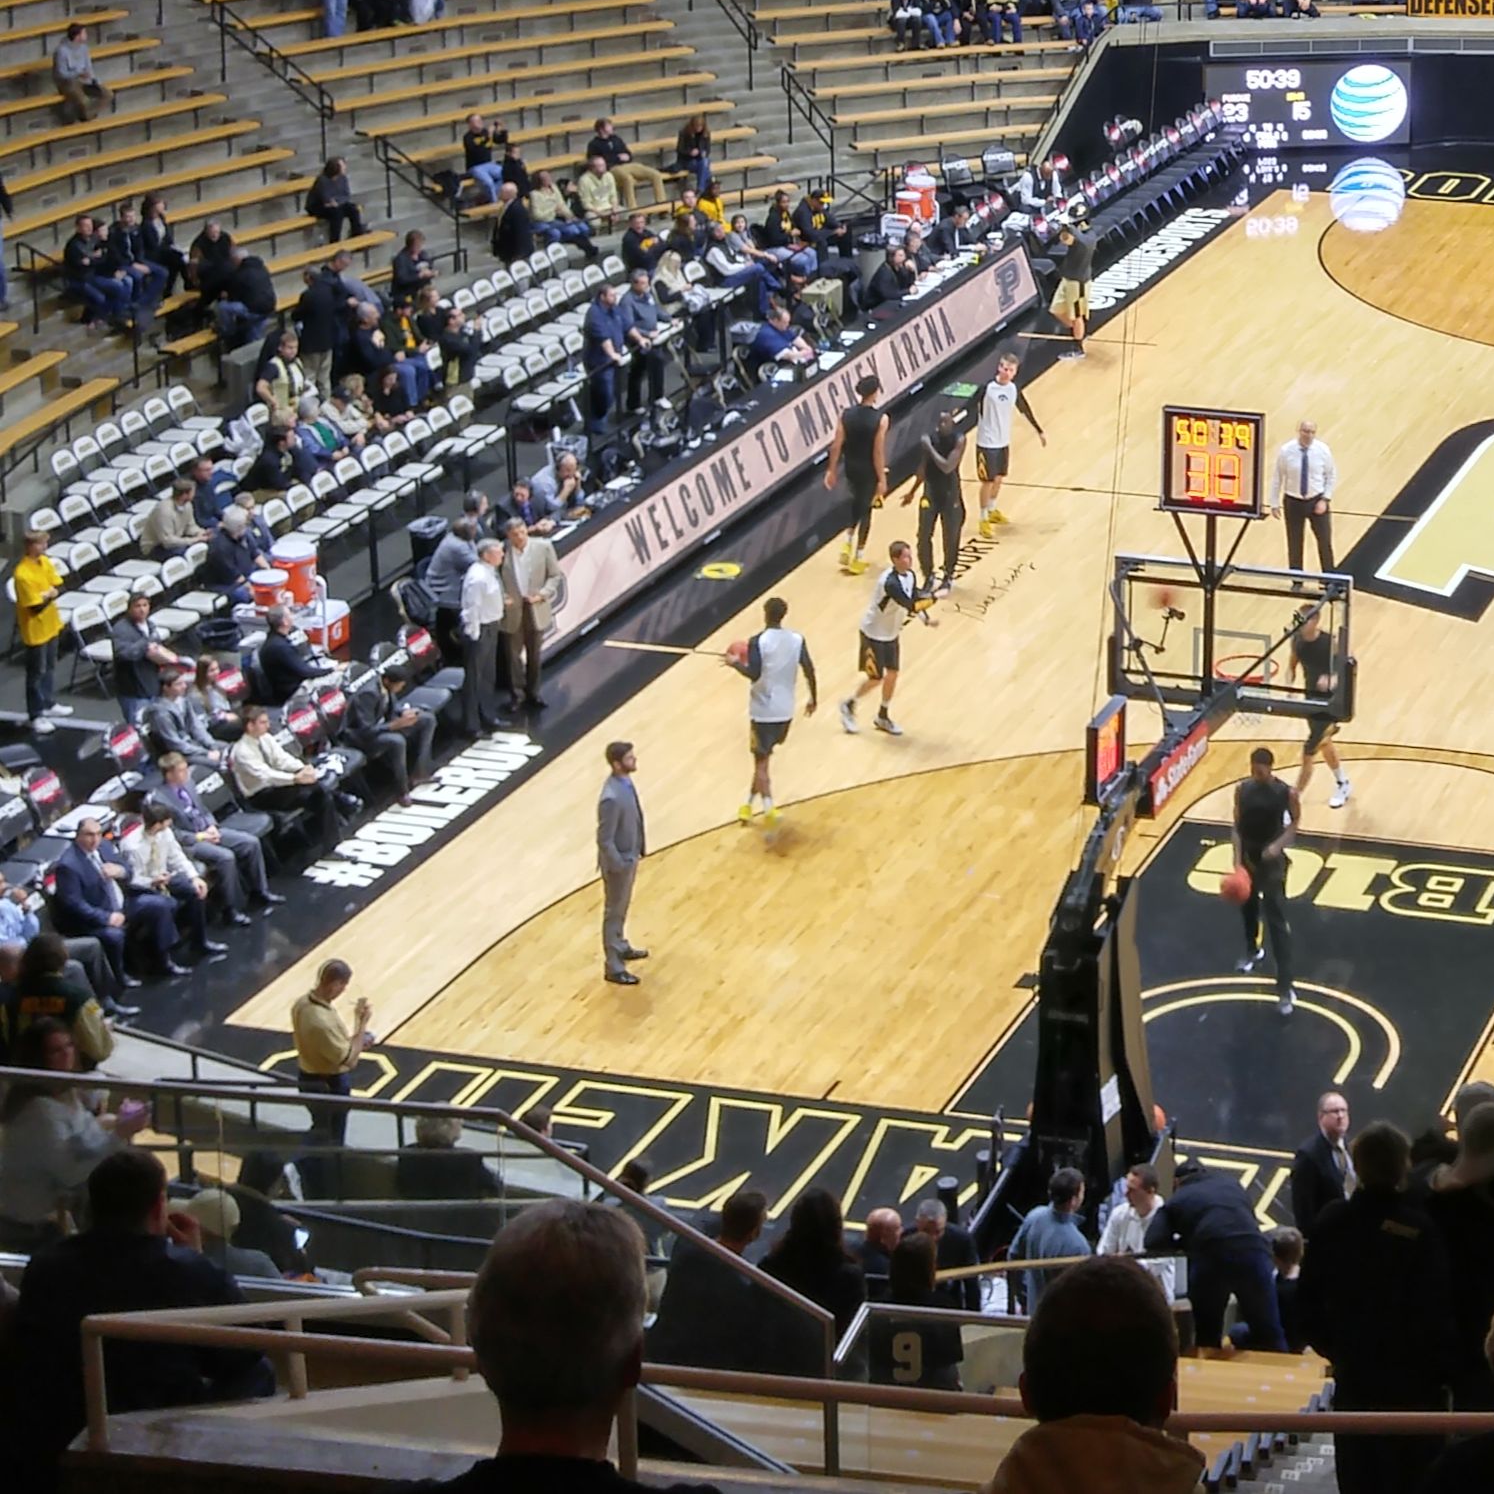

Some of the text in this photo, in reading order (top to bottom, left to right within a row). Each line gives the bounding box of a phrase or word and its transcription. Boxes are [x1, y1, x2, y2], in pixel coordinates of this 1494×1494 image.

[1292, 101, 1312, 122] 15
[625, 308, 956, 566] WELCOME TO MACKY ARENA
[1185, 450, 1242, 500] 30
[303, 731, 544, 888] #BOILERUP
[891, 1332, 923, 1385] 9
